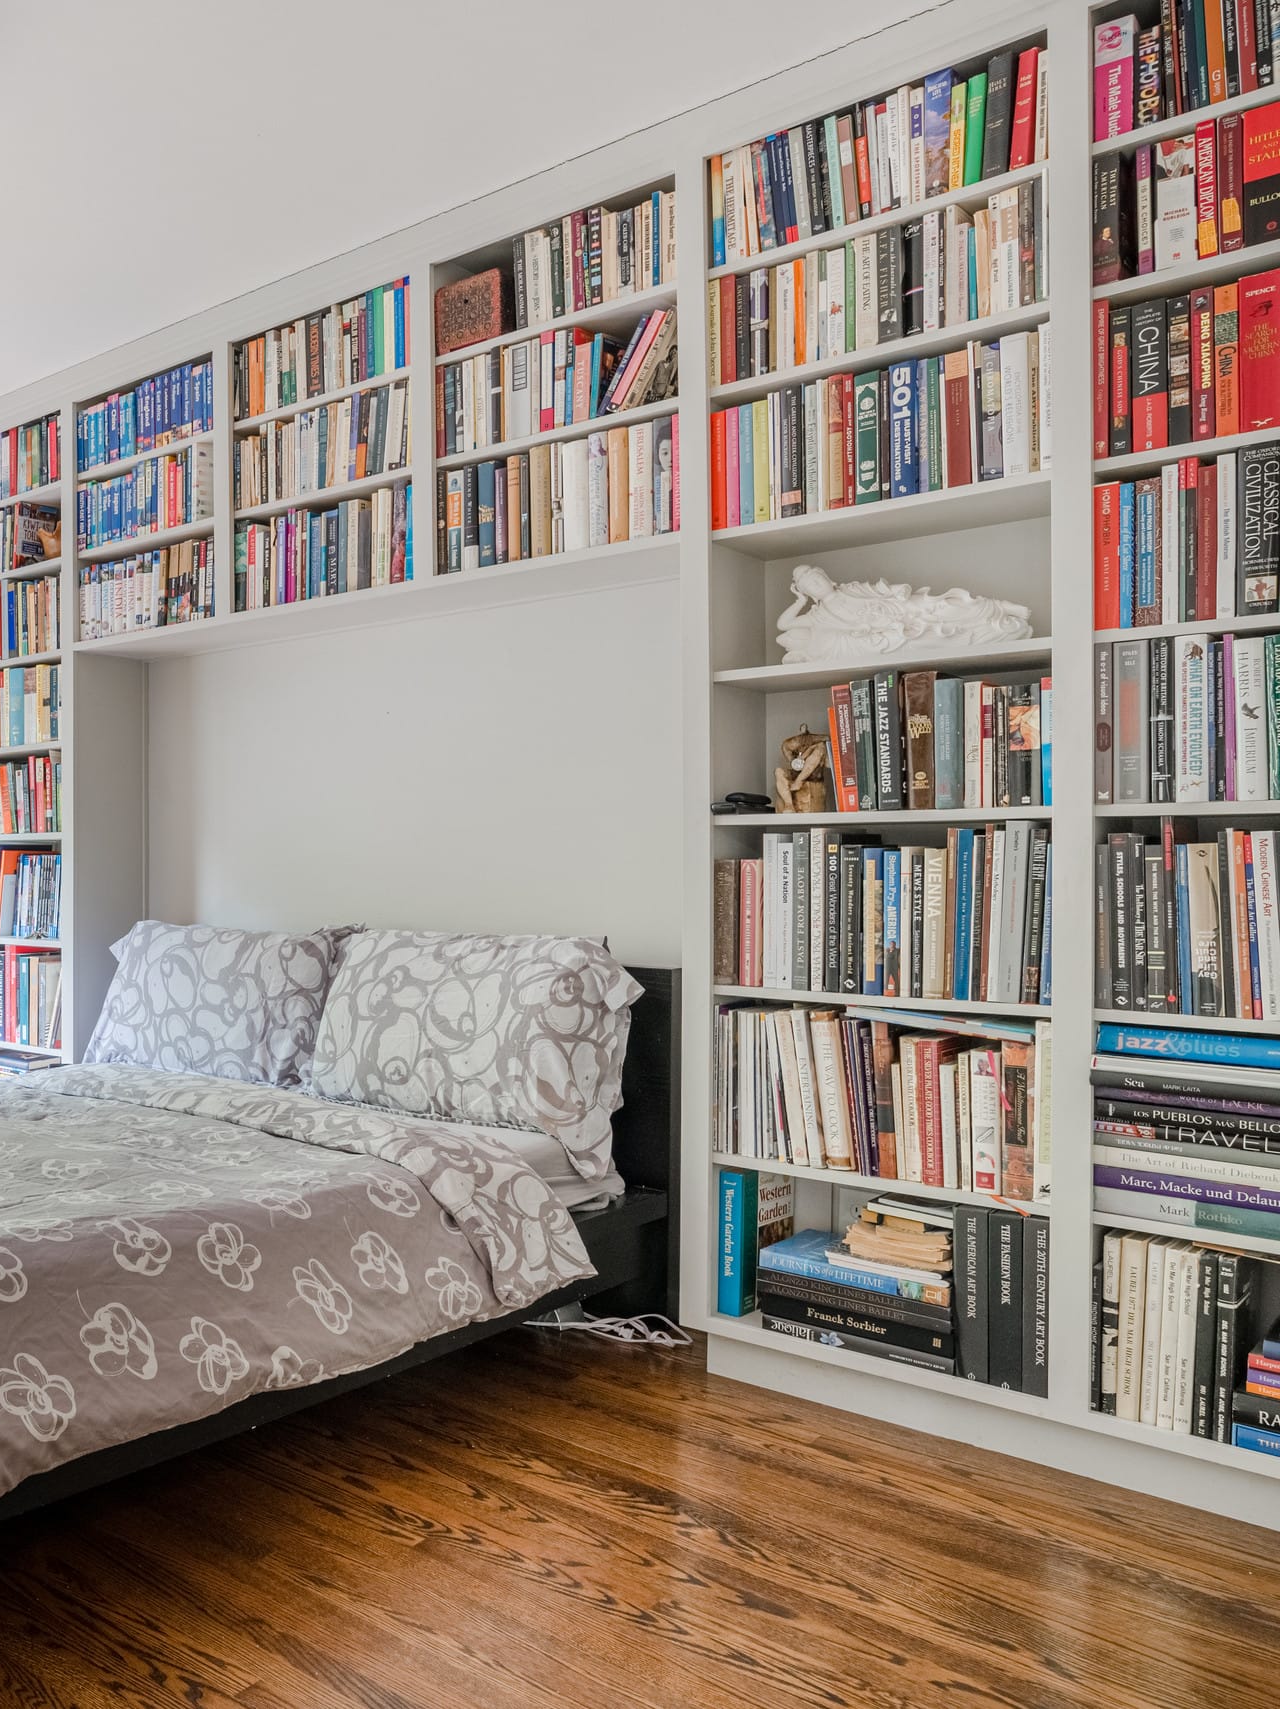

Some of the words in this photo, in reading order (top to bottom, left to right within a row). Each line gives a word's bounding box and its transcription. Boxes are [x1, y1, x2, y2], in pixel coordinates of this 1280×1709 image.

[1108, 65, 1122, 84] The
[1108, 86, 1121, 110] Male
[1108, 112, 1120, 138] Nude
[805, 124, 815, 168] MASTERPIECES
[1248, 150, 1280, 165] STALI
[1199, 138, 1215, 182] AMERICAN
[725, 176, 735, 193] THE
[1110, 169, 1118, 183] THE
[1100, 171, 1108, 210] AMERICAN
[1110, 186, 1118, 207] FIRST
[1200, 186, 1215, 221] DIPLOM
[1248, 190, 1280, 207] BULLO
[726, 196, 737, 250] HERMITAGE
[862, 259, 870, 271] ART
[863, 272, 870, 281] OF
[863, 283, 871, 310] EATING
[1245, 285, 1276, 298] SPENCE
[1201, 312, 1210, 339] DENG
[310, 325, 319, 355] MODERN
[310, 357, 319, 377] TIMES
[1138, 326, 1160, 394] CHINA
[1202, 342, 1211, 389] XIAOPING
[1218, 346, 1237, 377] CHINA
[575, 361, 584, 409] TUSCANY
[893, 366, 911, 420] 501
[986, 361, 995, 432] CHROMATOPIA
[894, 420, 902, 481] DESTINATIONS
[1245, 463, 1261, 559] CIVILIZATION
[1263, 460, 1279, 540] CLASSICAL
[1103, 489, 1111, 545] HOMOPHOBIA
[1190, 660, 1202, 685] WHAT
[1238, 652, 1249, 697] HARRIS
[878, 681, 887, 702] THE
[1190, 688, 1202, 699] ON
[879, 706, 889, 731] JAZZ
[1190, 701, 1202, 730] EARTH
[880, 733, 891, 793] STANDARDS
[1190, 732, 1202, 776] EVOLVED?
[1244, 727, 1257, 774] IMPERIUM
[829, 855, 837, 871] 100
[1116, 852, 1125, 875] STYLES,
[1259, 838, 1269, 871] MODERN
[829, 873, 838, 892] Great
[888, 855, 897, 886] Stephen
[914, 865, 922, 891] MEWS
[797, 867, 805, 902] ABOVE
[887, 888, 896, 901] Fry
[927, 857, 942, 918] VIENNA
[1116, 877, 1125, 907] SCHOOLS
[1246, 878, 1254, 890] The
[1261, 872, 1271, 901] CHINESE
[829, 894, 838, 926] Wonders
[914, 894, 922, 921] STYLE
[1247, 890, 1255, 910] Walker
[1263, 903, 1272, 917] ART
[797, 905, 805, 934] FROM
[888, 906, 897, 939] AMERICA
[1116, 909, 1125, 924] AND
[1248, 911, 1256, 921] Art
[829, 935, 837, 946] the
[1248, 922, 1257, 942] Gallery
[797, 939, 805, 963] PAST
[829, 948, 838, 968] World
[1116, 926, 1125, 968] MOVEMENTS
[822, 1042, 832, 1061] THE
[824, 1065, 834, 1087] WAY
[1124, 1077, 1144, 1088] Sea
[799, 1057, 814, 1128] ENTERTAINING
[827, 1092, 836, 1106] TO
[829, 1109, 839, 1139] COOK
[1133, 1110, 1149, 1118] LOS
[1152, 1109, 1212, 1126] PUEBLOS
[1121, 1152, 1142, 1163] The
[1146, 1155, 1161, 1166] Art
[1164, 1157, 1177, 1168] of
[1181, 1161, 1226, 1176] Richard
[1230, 1167, 1280, 1182] Diebenk
[1120, 1174, 1156, 1190] Marc,
[1159, 1180, 1202, 1196] Macke
[1205, 1188, 1232, 1200] und
[724, 1189, 735, 1221] Western
[758, 1203, 788, 1222] Garden
[1159, 1204, 1190, 1217] Mark
[1198, 1210, 1243, 1225] Rothko
[724, 1223, 734, 1253] Garden
[967, 1217, 976, 1233] THE
[1001, 1224, 1011, 1243] THE
[1036, 1229, 1046, 1248] THE
[724, 1255, 734, 1277] Book
[967, 1234, 976, 1275] AMERICAN
[1001, 1243, 1011, 1279] FASHION
[1036, 1249, 1046, 1272] 20TH
[771, 1255, 821, 1273] JOURNEYS
[834, 1270, 884, 1288] LIFETIME
[967, 1277, 976, 1292] ART
[1129, 1266, 1138, 1293] LAUREL
[770, 1273, 808, 1287] ALONZO
[810, 1279, 836, 1292] KING
[838, 1284, 866, 1300] LINES
[869, 1292, 906, 1308] BALLET
[770, 1285, 809, 1300] ALONZO
[810, 1291, 836, 1305] KING
[838, 1298, 867, 1312] LINES
[869, 1306, 906, 1321] BALLET
[1001, 1280, 1011, 1304] BOOK
[1036, 1273, 1046, 1318] CENTURY
[967, 1295, 976, 1318] BOOK
[806, 1307, 844, 1325] Franck
[846, 1317, 887, 1335] Sorbier
[1036, 1318, 1045, 1337] ART
[1035, 1338, 1045, 1366] BOOK
[1125, 1347, 1133, 1367] HIGH
